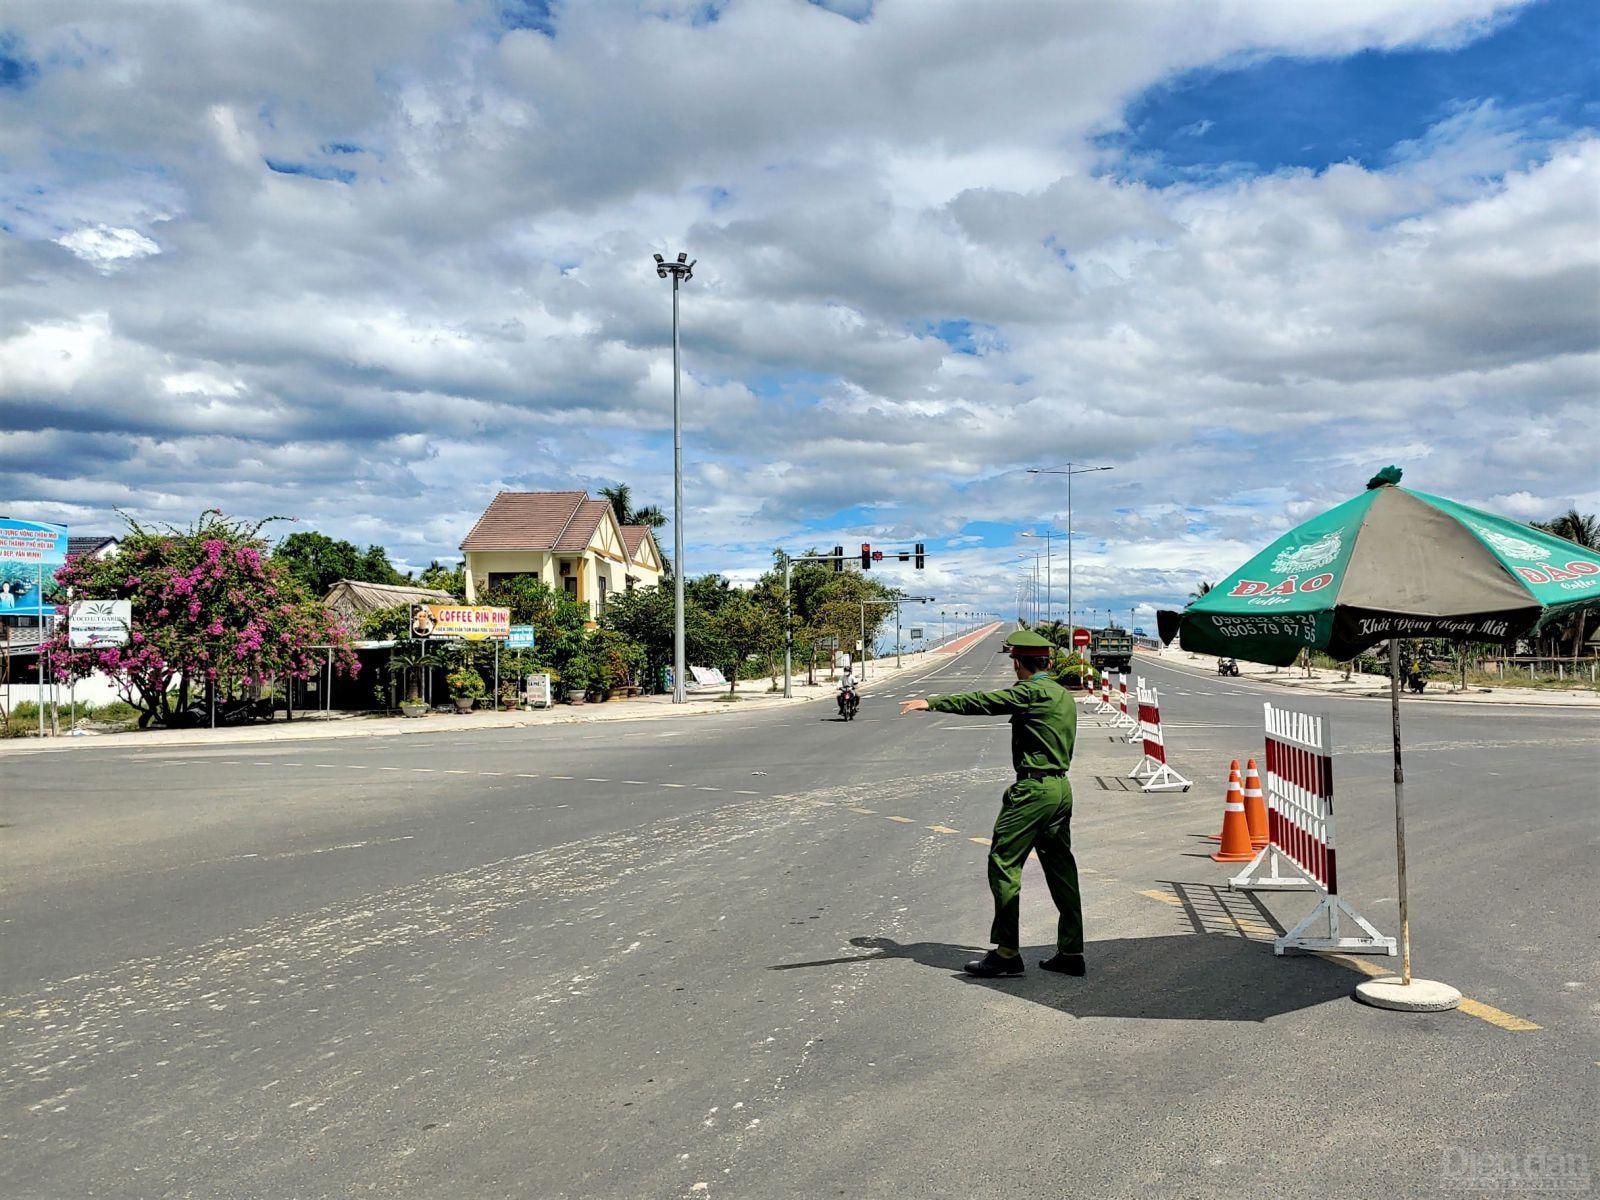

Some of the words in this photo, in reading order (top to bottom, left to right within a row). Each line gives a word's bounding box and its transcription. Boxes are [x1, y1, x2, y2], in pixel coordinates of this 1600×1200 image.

[439, 610, 472, 623] COFFEE
[475, 611, 489, 623] RIN
[1219, 623, 1280, 637] 0905.79
[1283, 624, 1300, 637] 47
[1304, 625, 1316, 643] 55
